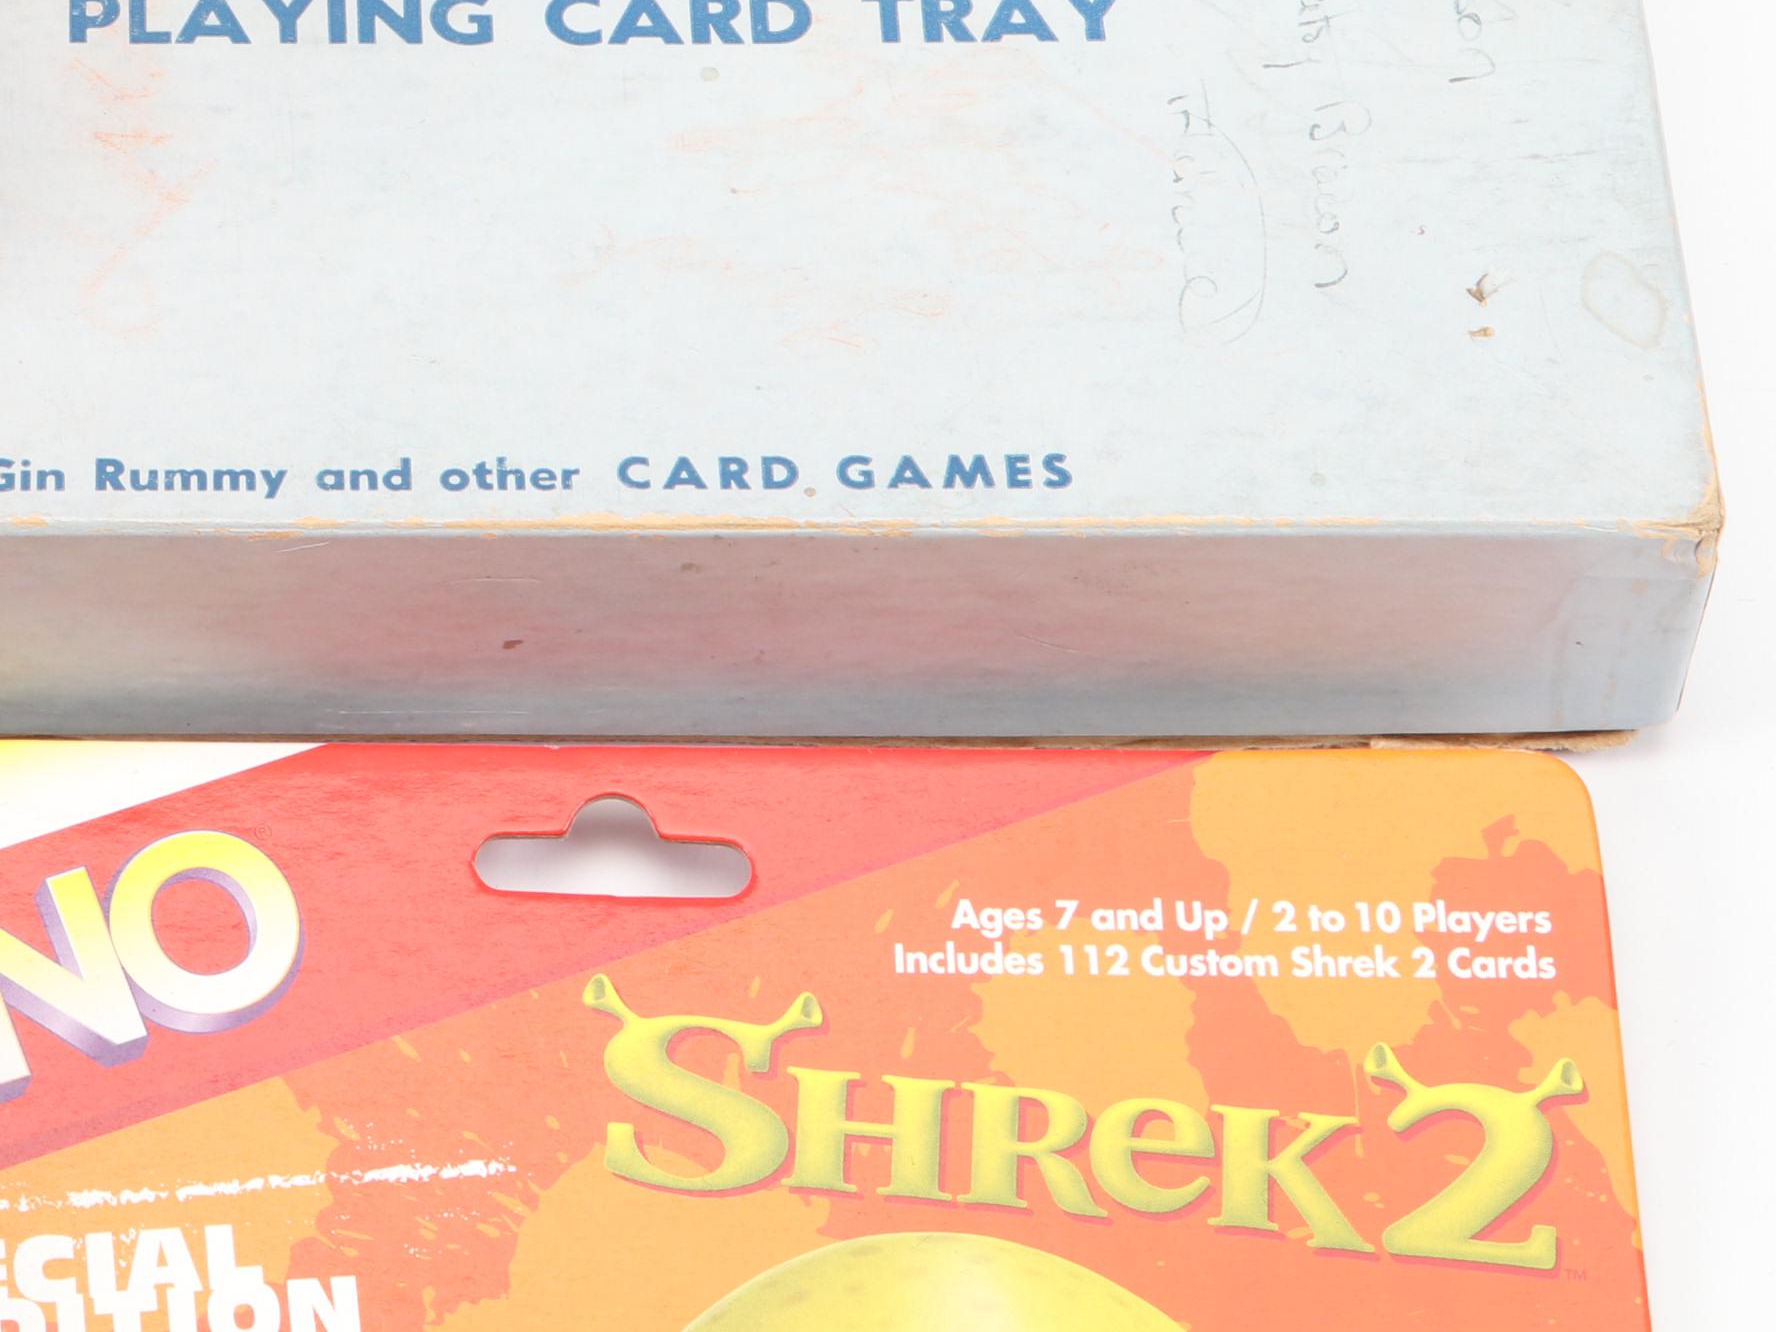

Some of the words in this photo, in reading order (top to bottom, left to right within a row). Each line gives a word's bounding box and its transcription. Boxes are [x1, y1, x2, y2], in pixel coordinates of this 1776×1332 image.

[94, 457, 288, 499] Rummy
[314, 457, 412, 491] and
[439, 455, 580, 491] other
[616, 454, 800, 490] CARD
[836, 453, 1074, 489] GAMES
[951, 898, 1044, 939] Ages
[1054, 899, 1082, 930] 7
[1090, 897, 1165, 932] and
[1174, 899, 1228, 939] Up
[1240, 898, 1258, 936] /
[1273, 900, 1298, 932] 2
[1308, 901, 1346, 933] to
[1355, 901, 1402, 933] 10
[1413, 901, 1553, 943] Players
[893, 941, 1044, 976] Includes
[1058, 943, 1130, 976] 112
[1141, 943, 1281, 978] Custom
[1291, 944, 1401, 979] Shrek
[1410, 946, 1436, 979] 2
[1447, 946, 1557, 980] Cards
[1364, 1043, 1585, 1271] 2
